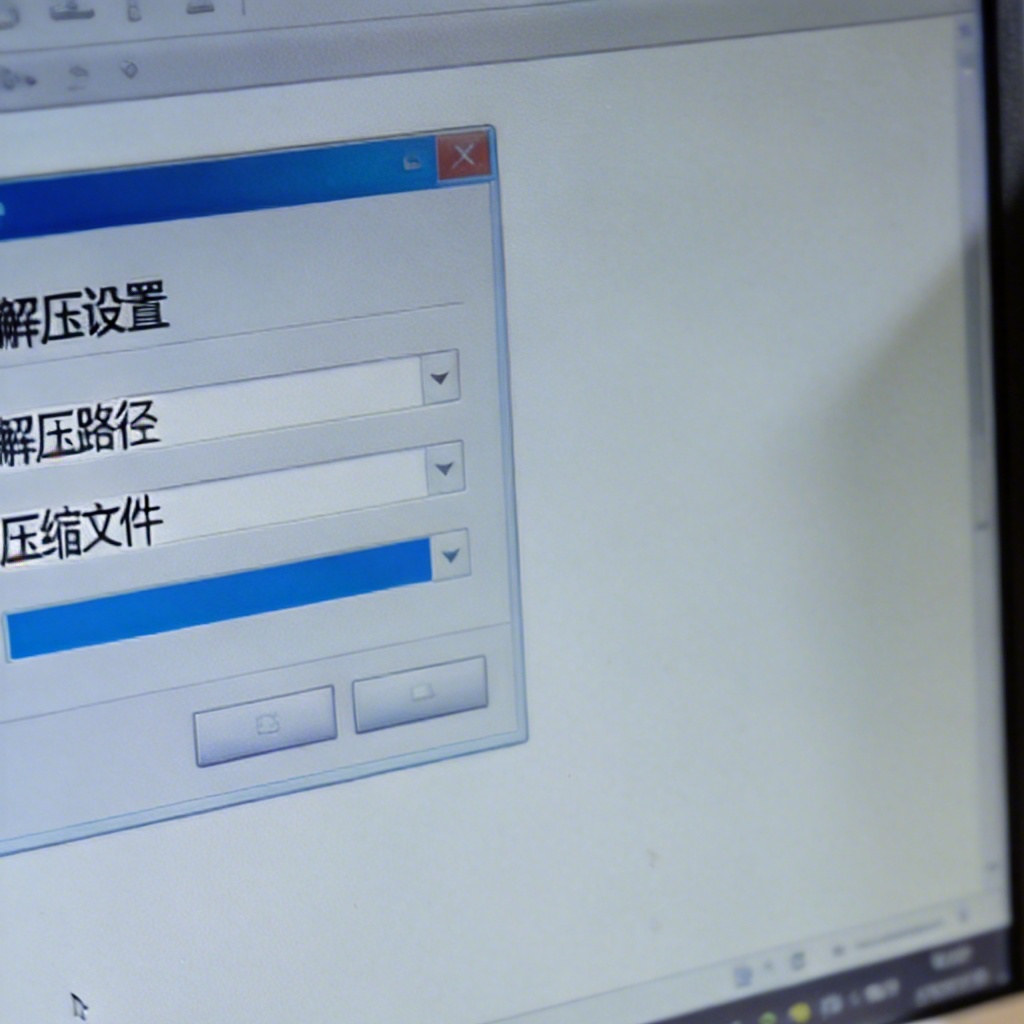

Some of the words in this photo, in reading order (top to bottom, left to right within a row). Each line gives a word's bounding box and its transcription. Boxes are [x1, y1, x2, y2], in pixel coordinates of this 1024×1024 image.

[0, 280, 170, 349] 解压设置
[0, 400, 161, 466] 解压路径
[0, 494, 163, 566] 压缩文件
